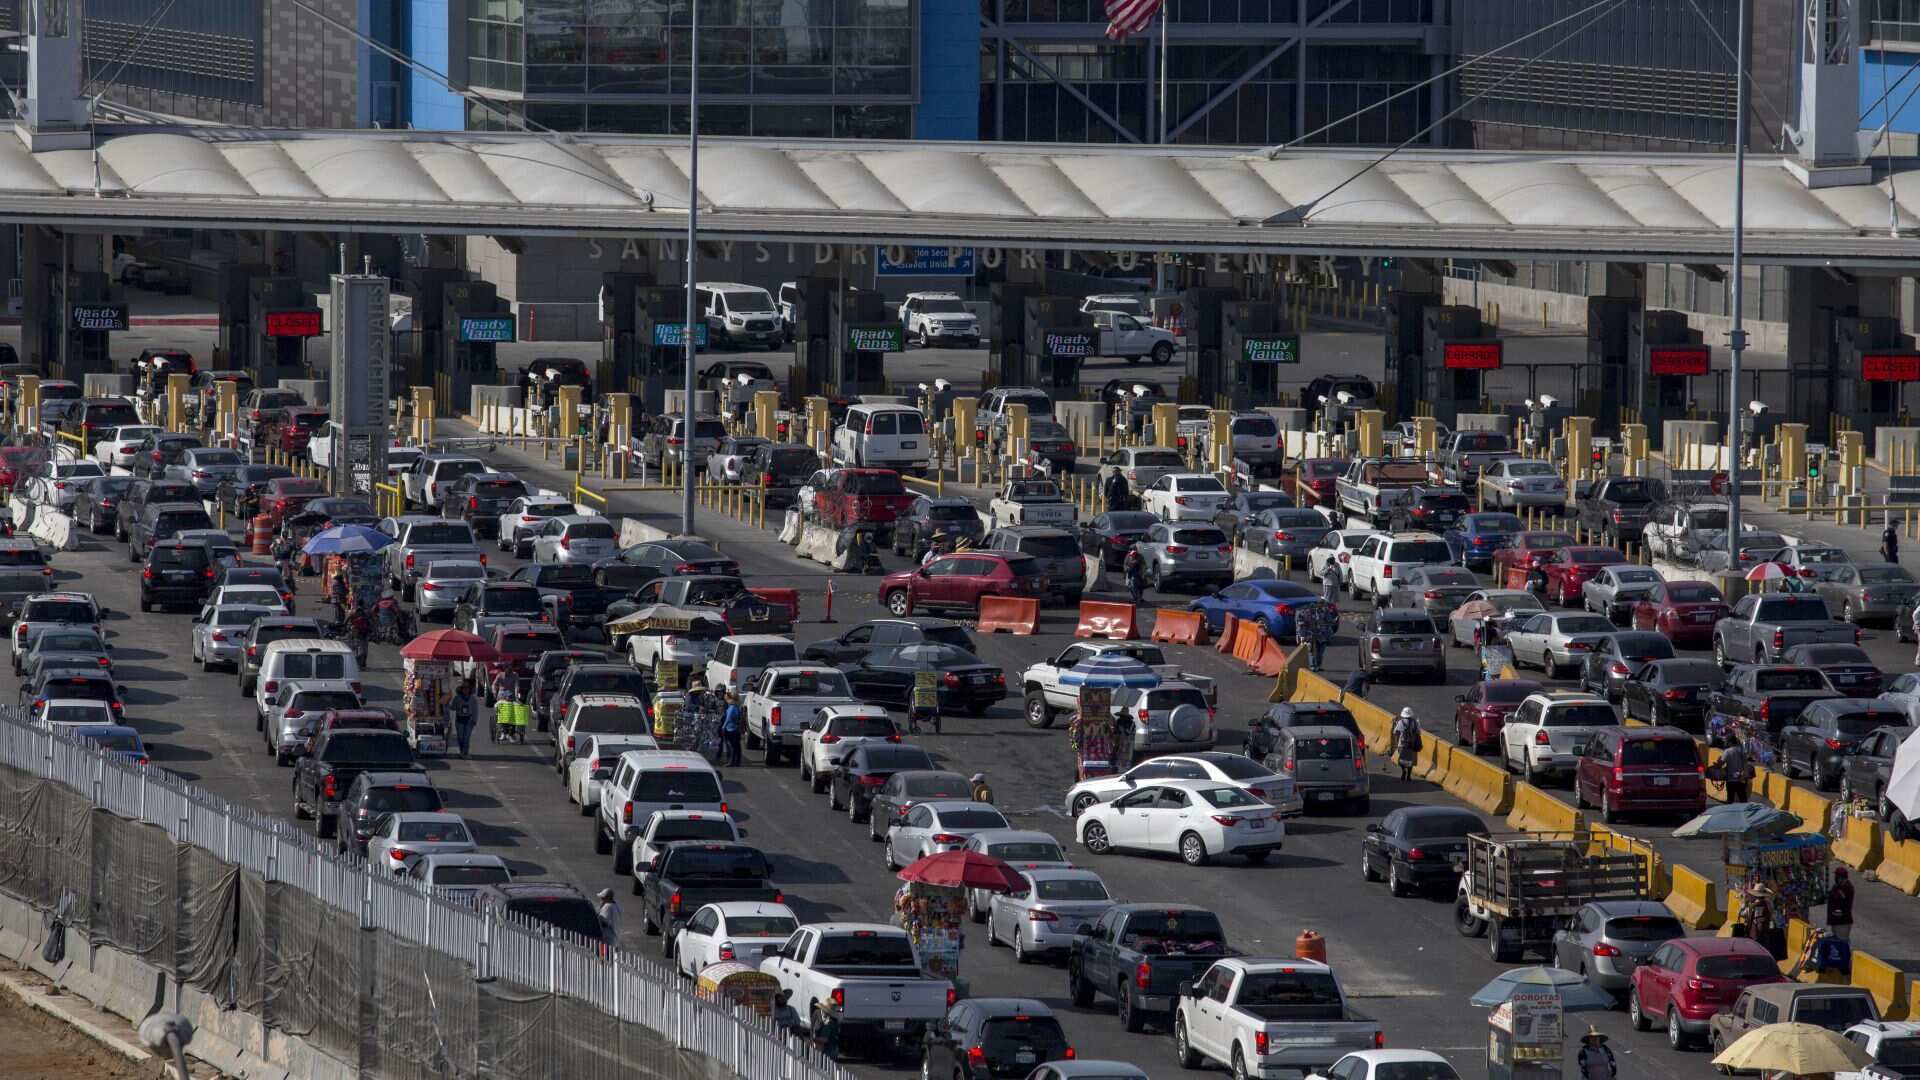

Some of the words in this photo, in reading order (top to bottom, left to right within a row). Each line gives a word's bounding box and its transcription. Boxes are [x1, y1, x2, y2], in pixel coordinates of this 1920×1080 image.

[589, 238, 678, 260] SAN
[721, 240, 906, 266] YSIDRO
[74, 307, 119, 321] Ready
[367, 285, 384, 350] STATES
[463, 319, 506, 333] Ready
[851, 329, 895, 343] Ready
[857, 336, 890, 350] Lane
[1047, 334, 1090, 349] Ready
[1052, 343, 1087, 355] Lane
[1245, 339, 1290, 354] Ready
[1251, 350, 1285, 361] Lane
[367, 356, 384, 425] UNITED
[651, 617, 689, 630] TAMALES
[1514, 993, 1560, 1001] GORDITAS
